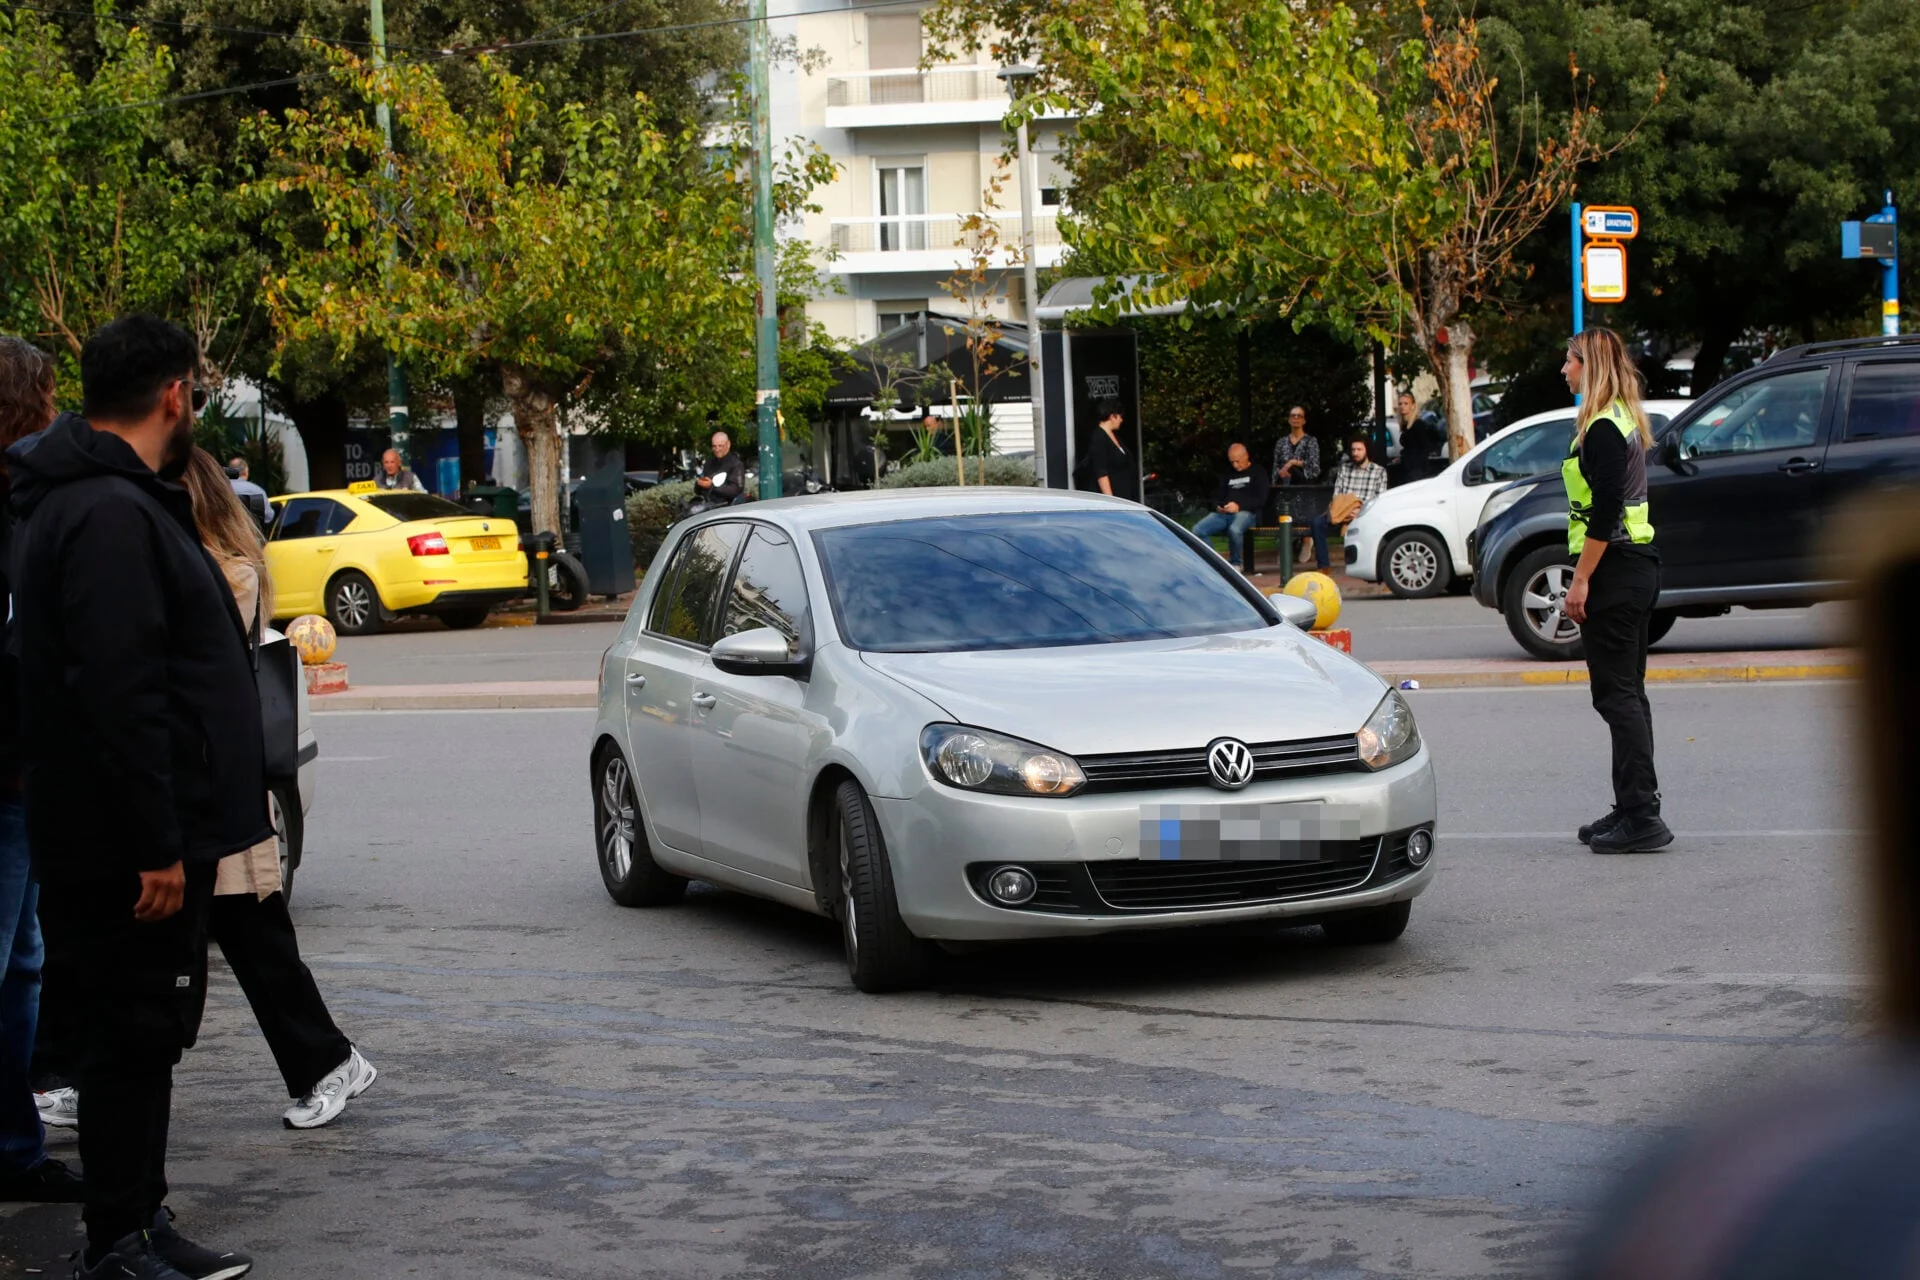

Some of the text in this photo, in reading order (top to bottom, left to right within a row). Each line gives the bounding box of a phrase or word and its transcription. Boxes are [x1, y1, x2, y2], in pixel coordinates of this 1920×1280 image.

[344, 444, 362, 460] TO
[346, 462, 371, 479] RED
[357, 482, 375, 490] TAXI
